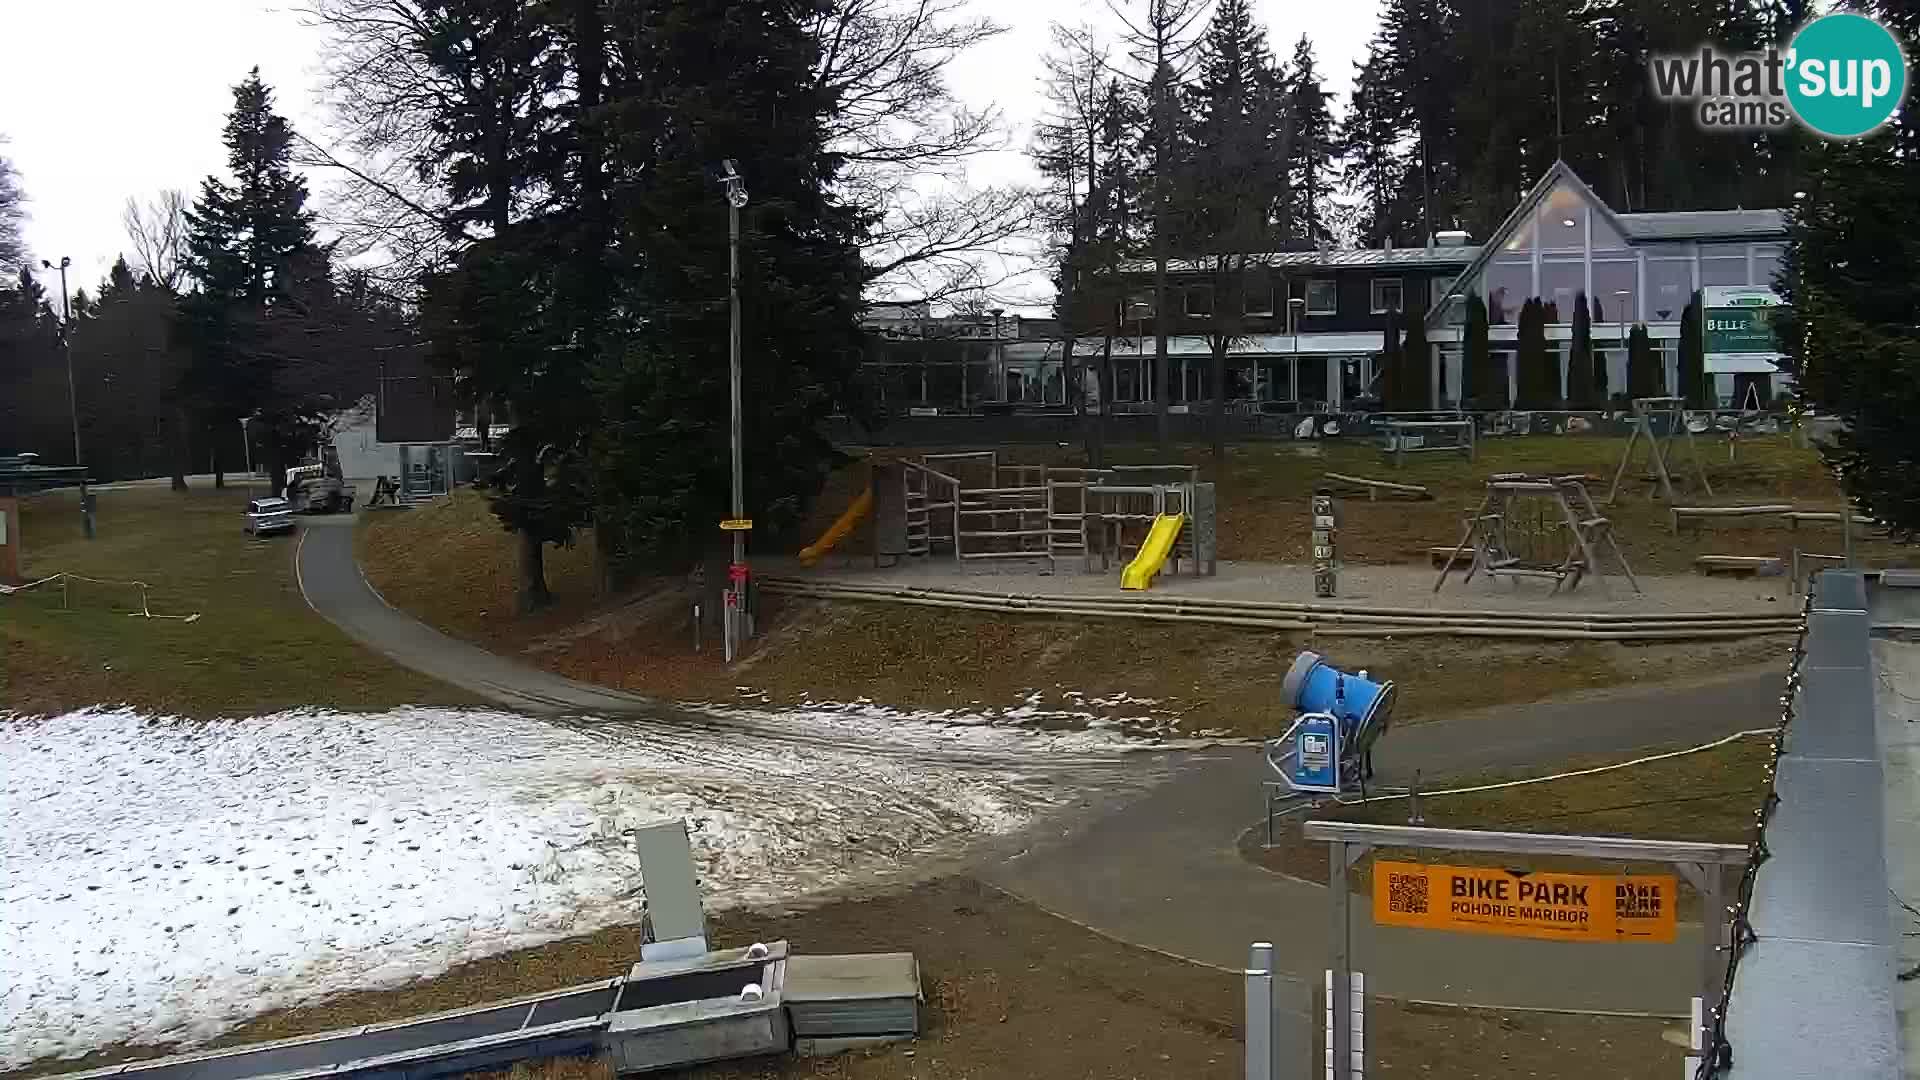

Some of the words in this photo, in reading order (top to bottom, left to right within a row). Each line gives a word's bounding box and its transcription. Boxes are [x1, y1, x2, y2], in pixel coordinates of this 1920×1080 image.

[1451, 876, 1509, 900] BIKE
[1518, 881, 1589, 906] PARK
[1519, 906, 1589, 923] MARIBOR
